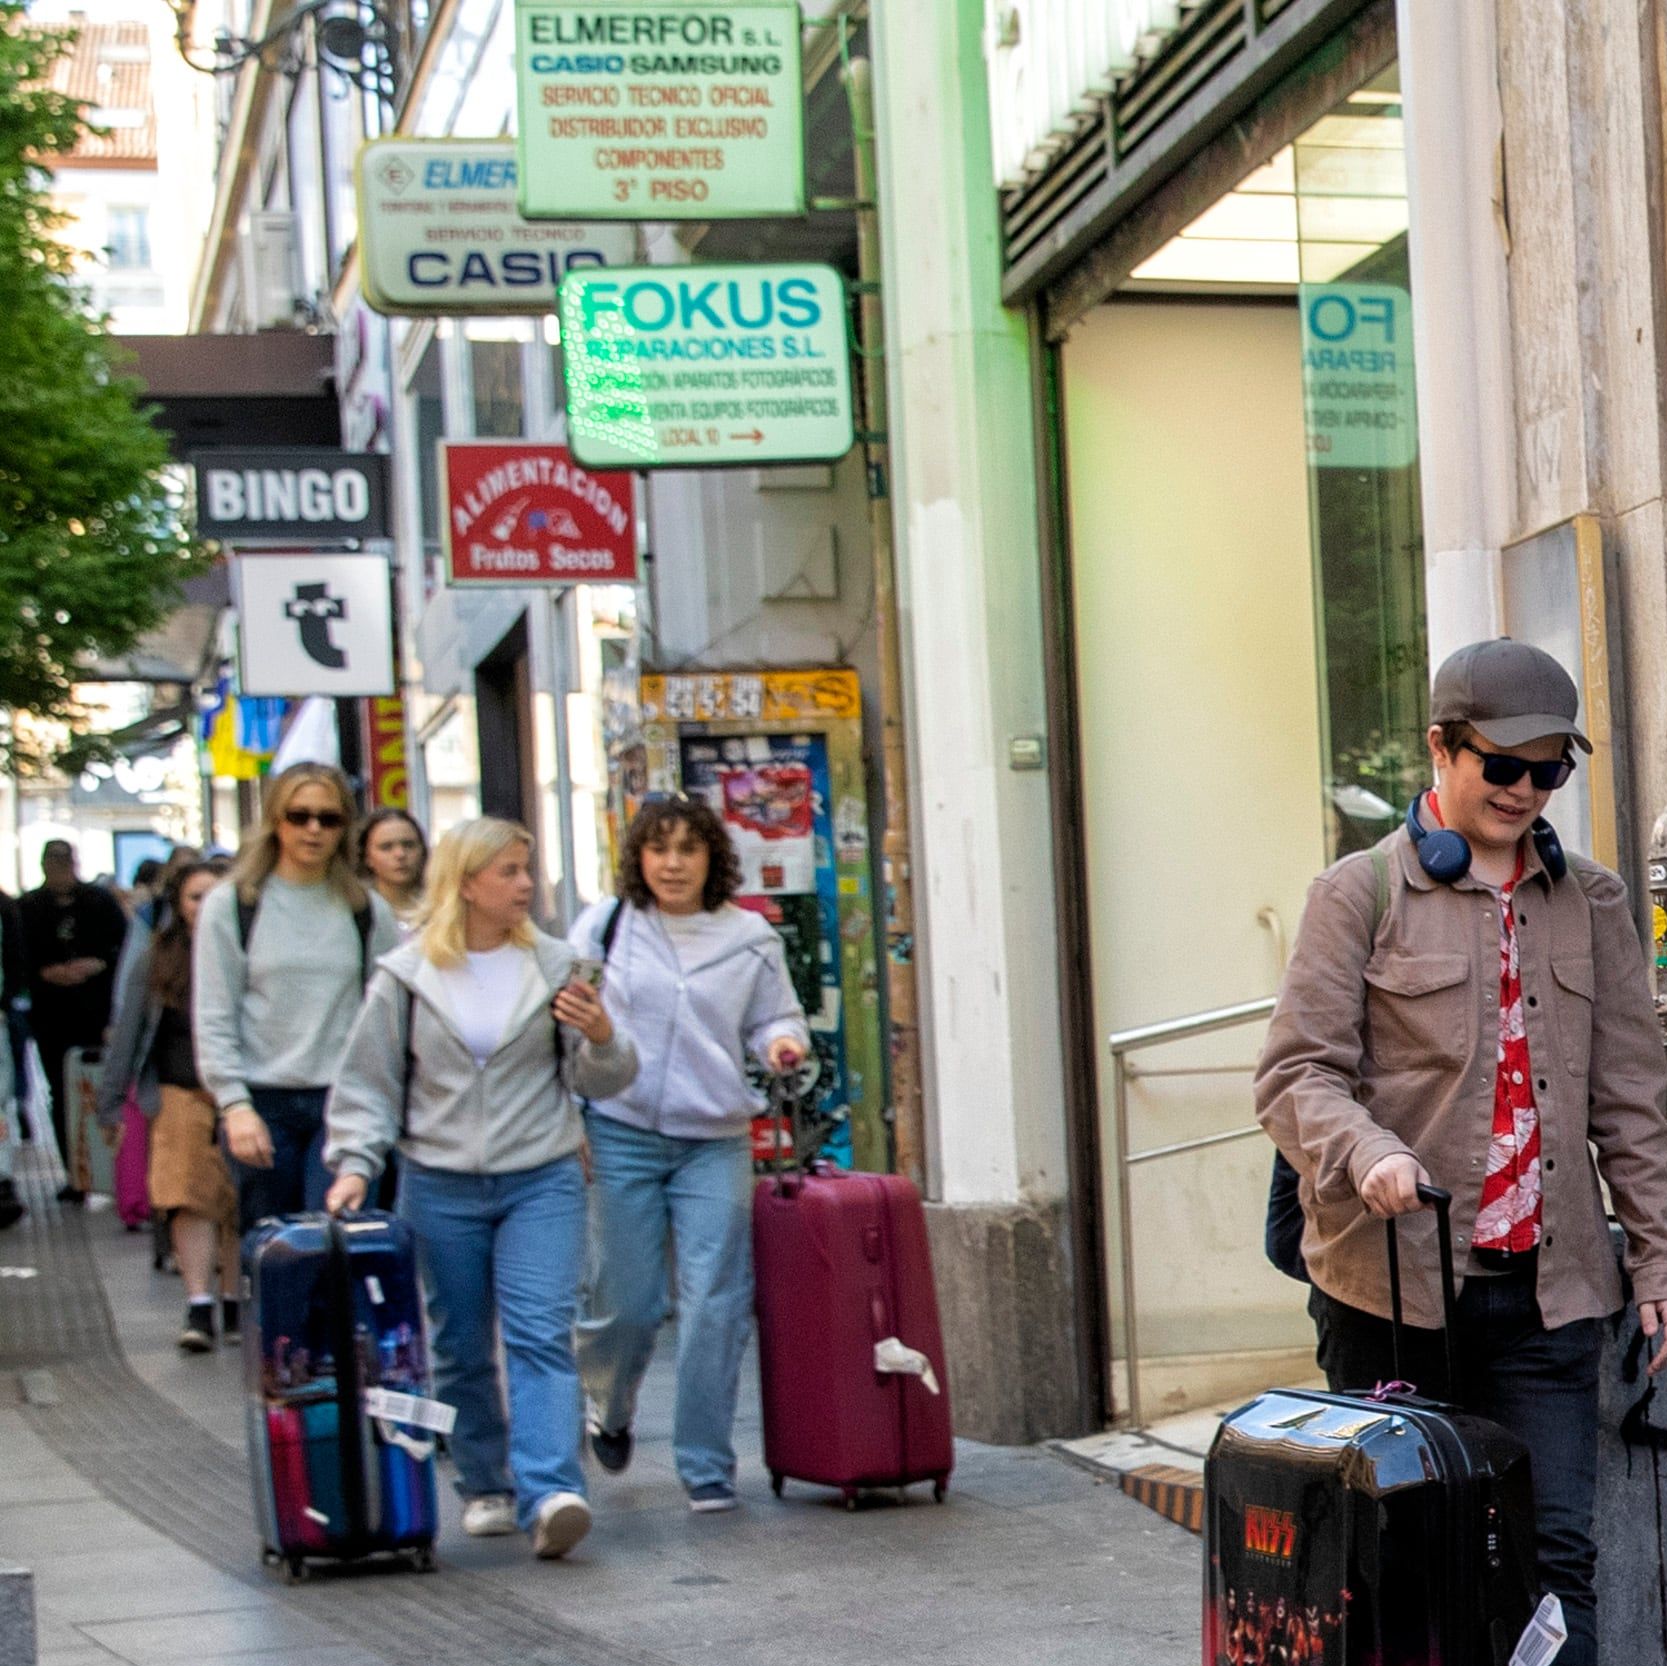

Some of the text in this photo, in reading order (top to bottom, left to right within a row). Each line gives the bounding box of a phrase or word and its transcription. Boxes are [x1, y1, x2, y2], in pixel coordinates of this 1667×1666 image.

[530, 15, 733, 46] ELMERFOR
[530, 55, 782, 75] CASIO SAMSUNG
[541, 85, 774, 107] SERVICIO TECNICO OFICIAL
[549, 117, 768, 139] DISTRIBUIDOR EXCLUSIVO
[595, 148, 725, 170] COMPONENTES
[650, 180, 710, 202] PISO
[426, 226, 504, 242] SERVICIO
[581, 279, 822, 331] FOKUS
[207, 468, 369, 522] BINGO
[453, 456, 629, 538] ALIMENTACION
[470, 542, 615, 571] Frutos Secos
[1244, 1504, 1297, 1558] KISS
